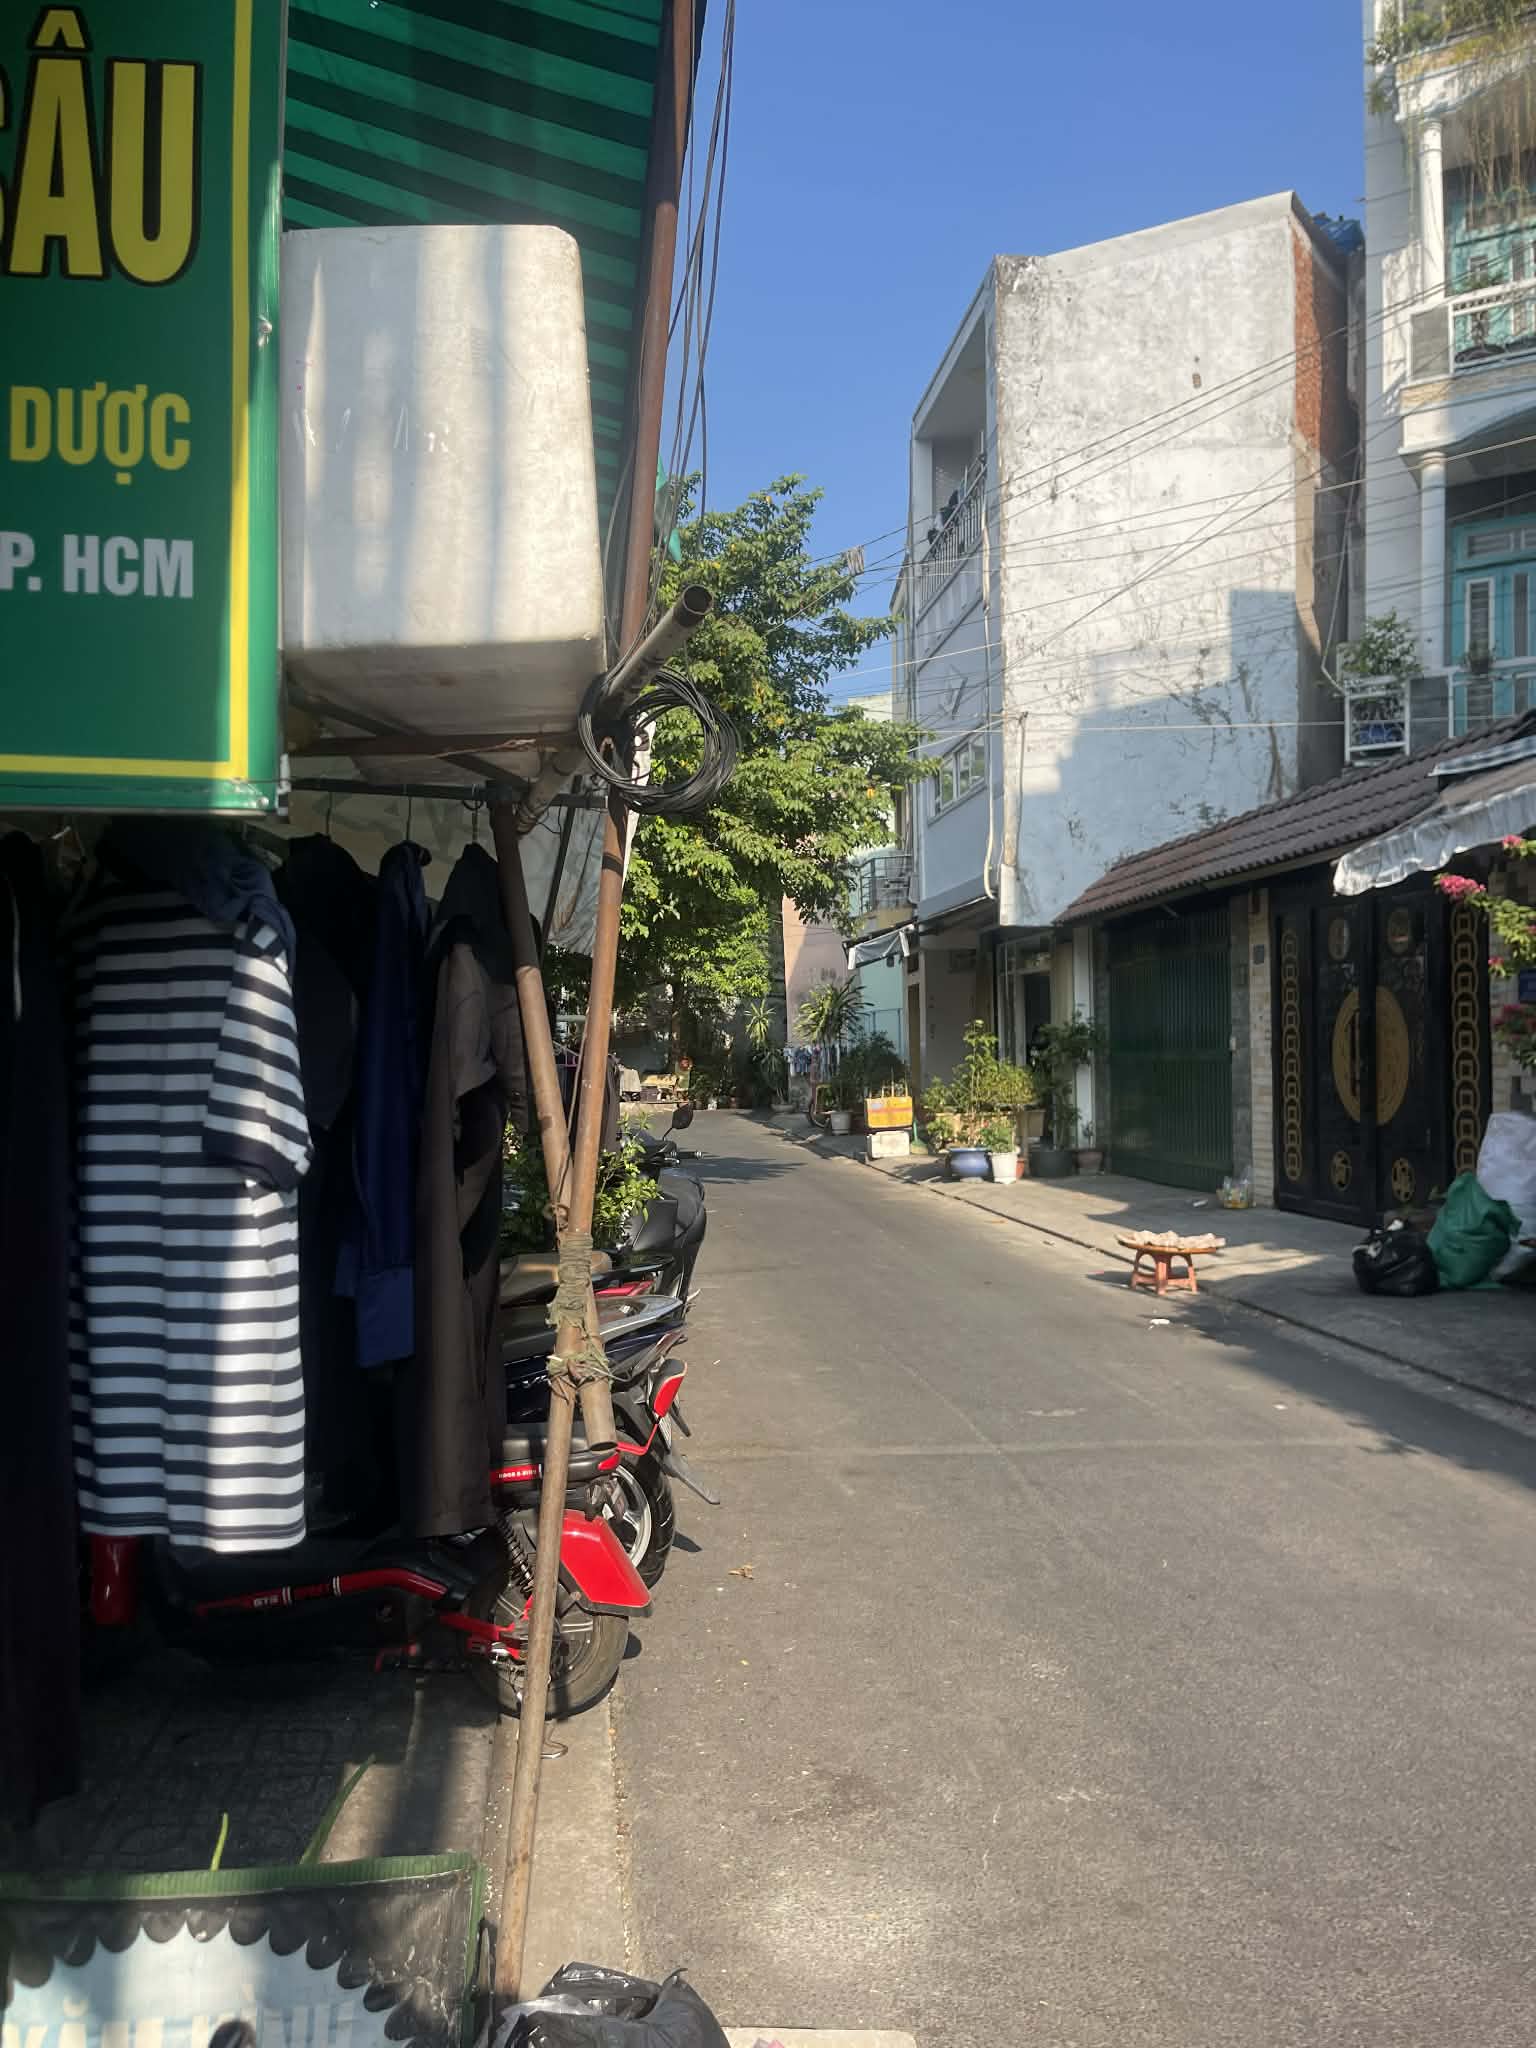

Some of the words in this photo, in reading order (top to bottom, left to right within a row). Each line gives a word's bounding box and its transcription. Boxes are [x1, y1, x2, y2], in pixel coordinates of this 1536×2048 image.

[0, 7, 201, 285] ÂU
[10, 381, 191, 485] DƯỢC
[63, 534, 193, 598] HCM
